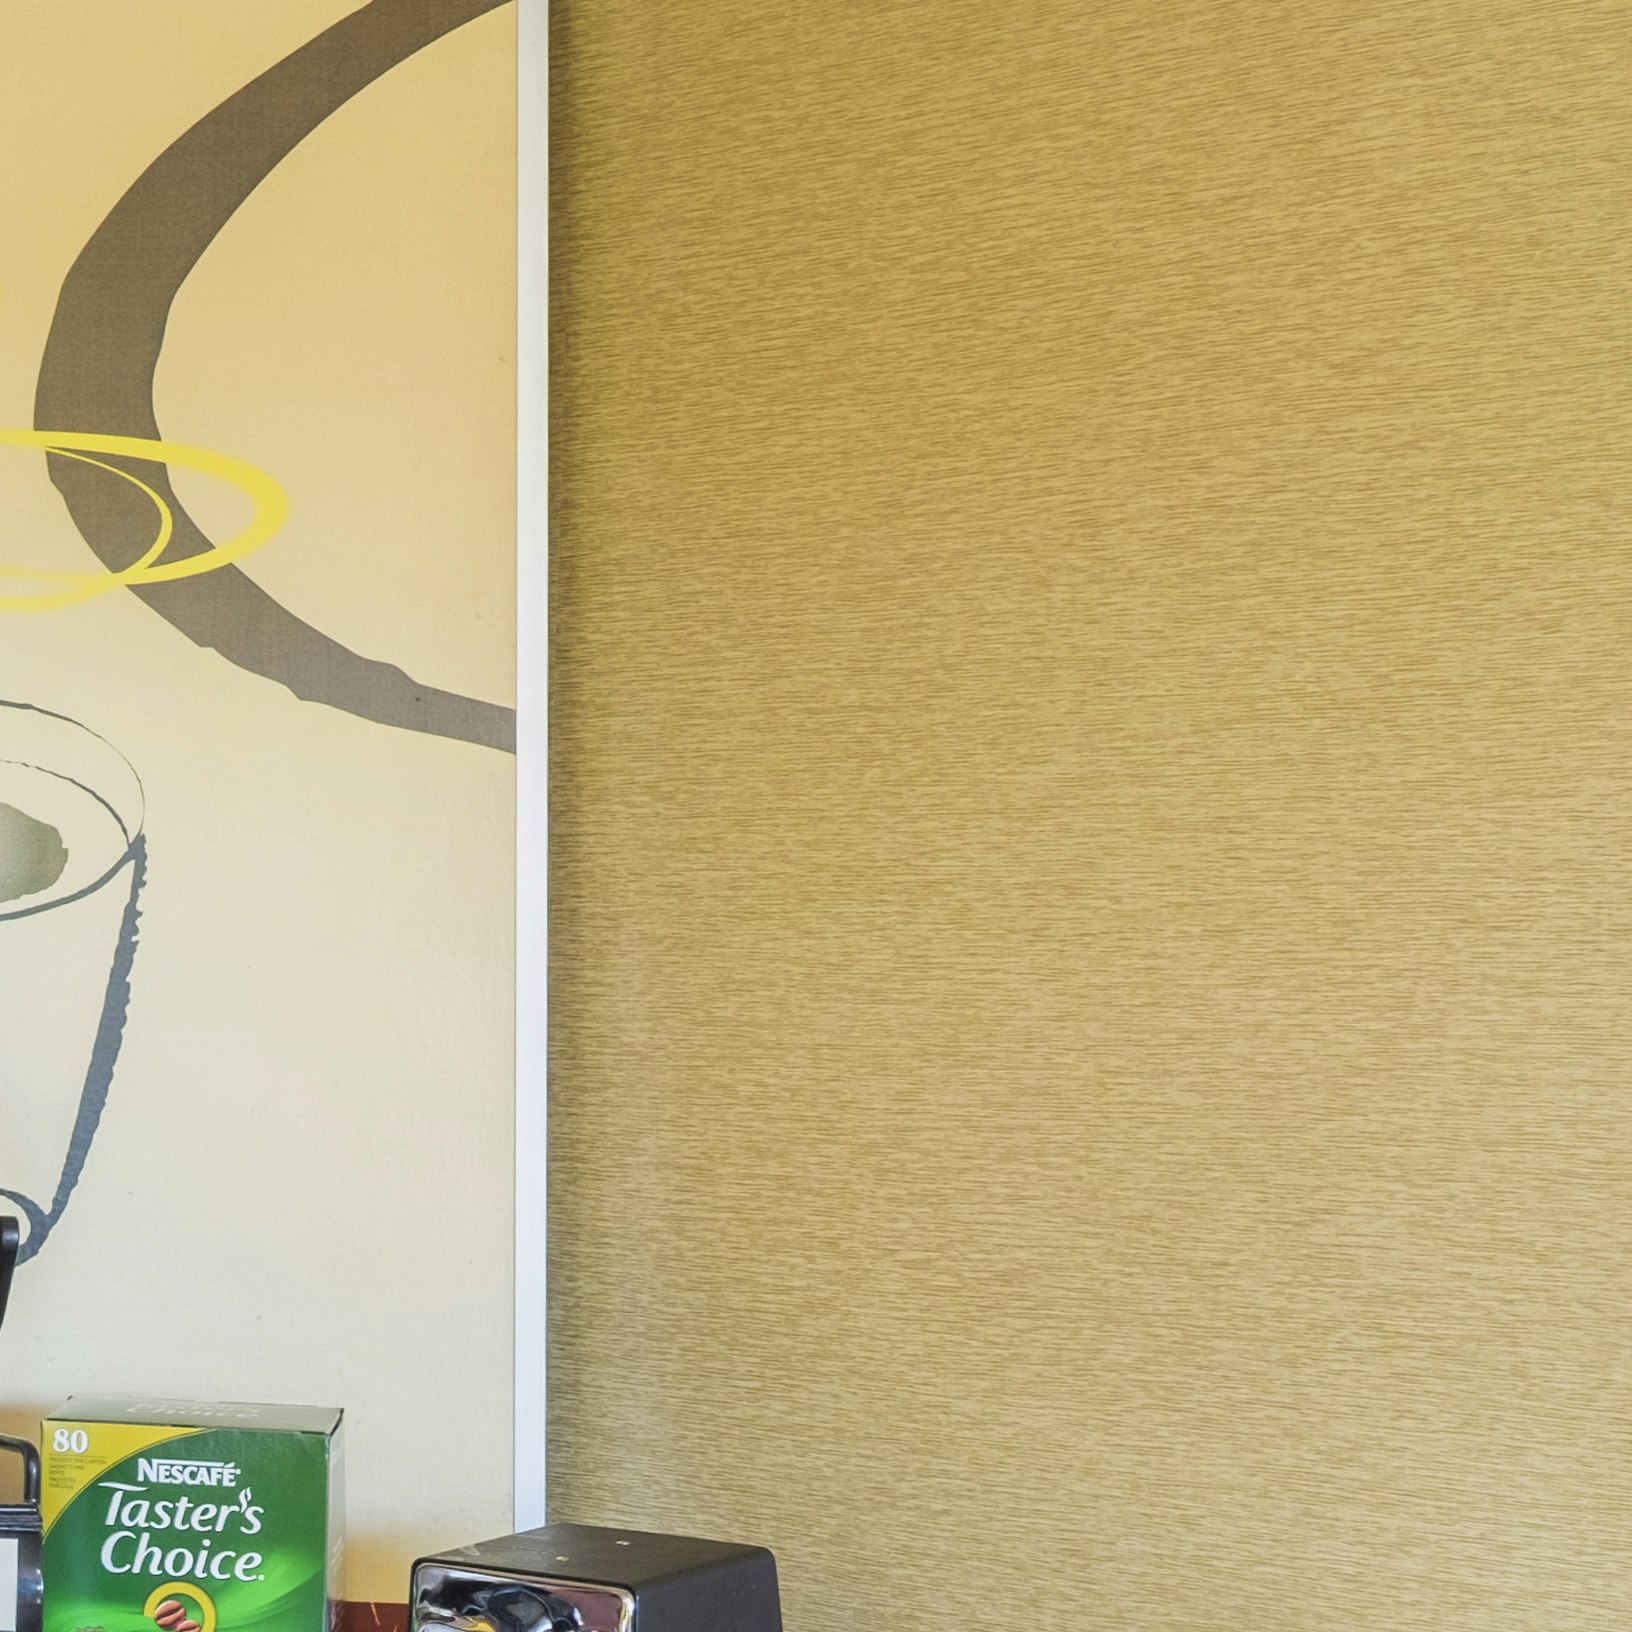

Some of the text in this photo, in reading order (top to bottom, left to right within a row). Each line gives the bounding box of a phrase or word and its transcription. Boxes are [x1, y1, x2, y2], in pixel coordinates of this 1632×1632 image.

[52, 1428, 89, 1454] 80
[137, 1458, 237, 1487] NESCAFÉ
[97, 1487, 264, 1534] Taster's
